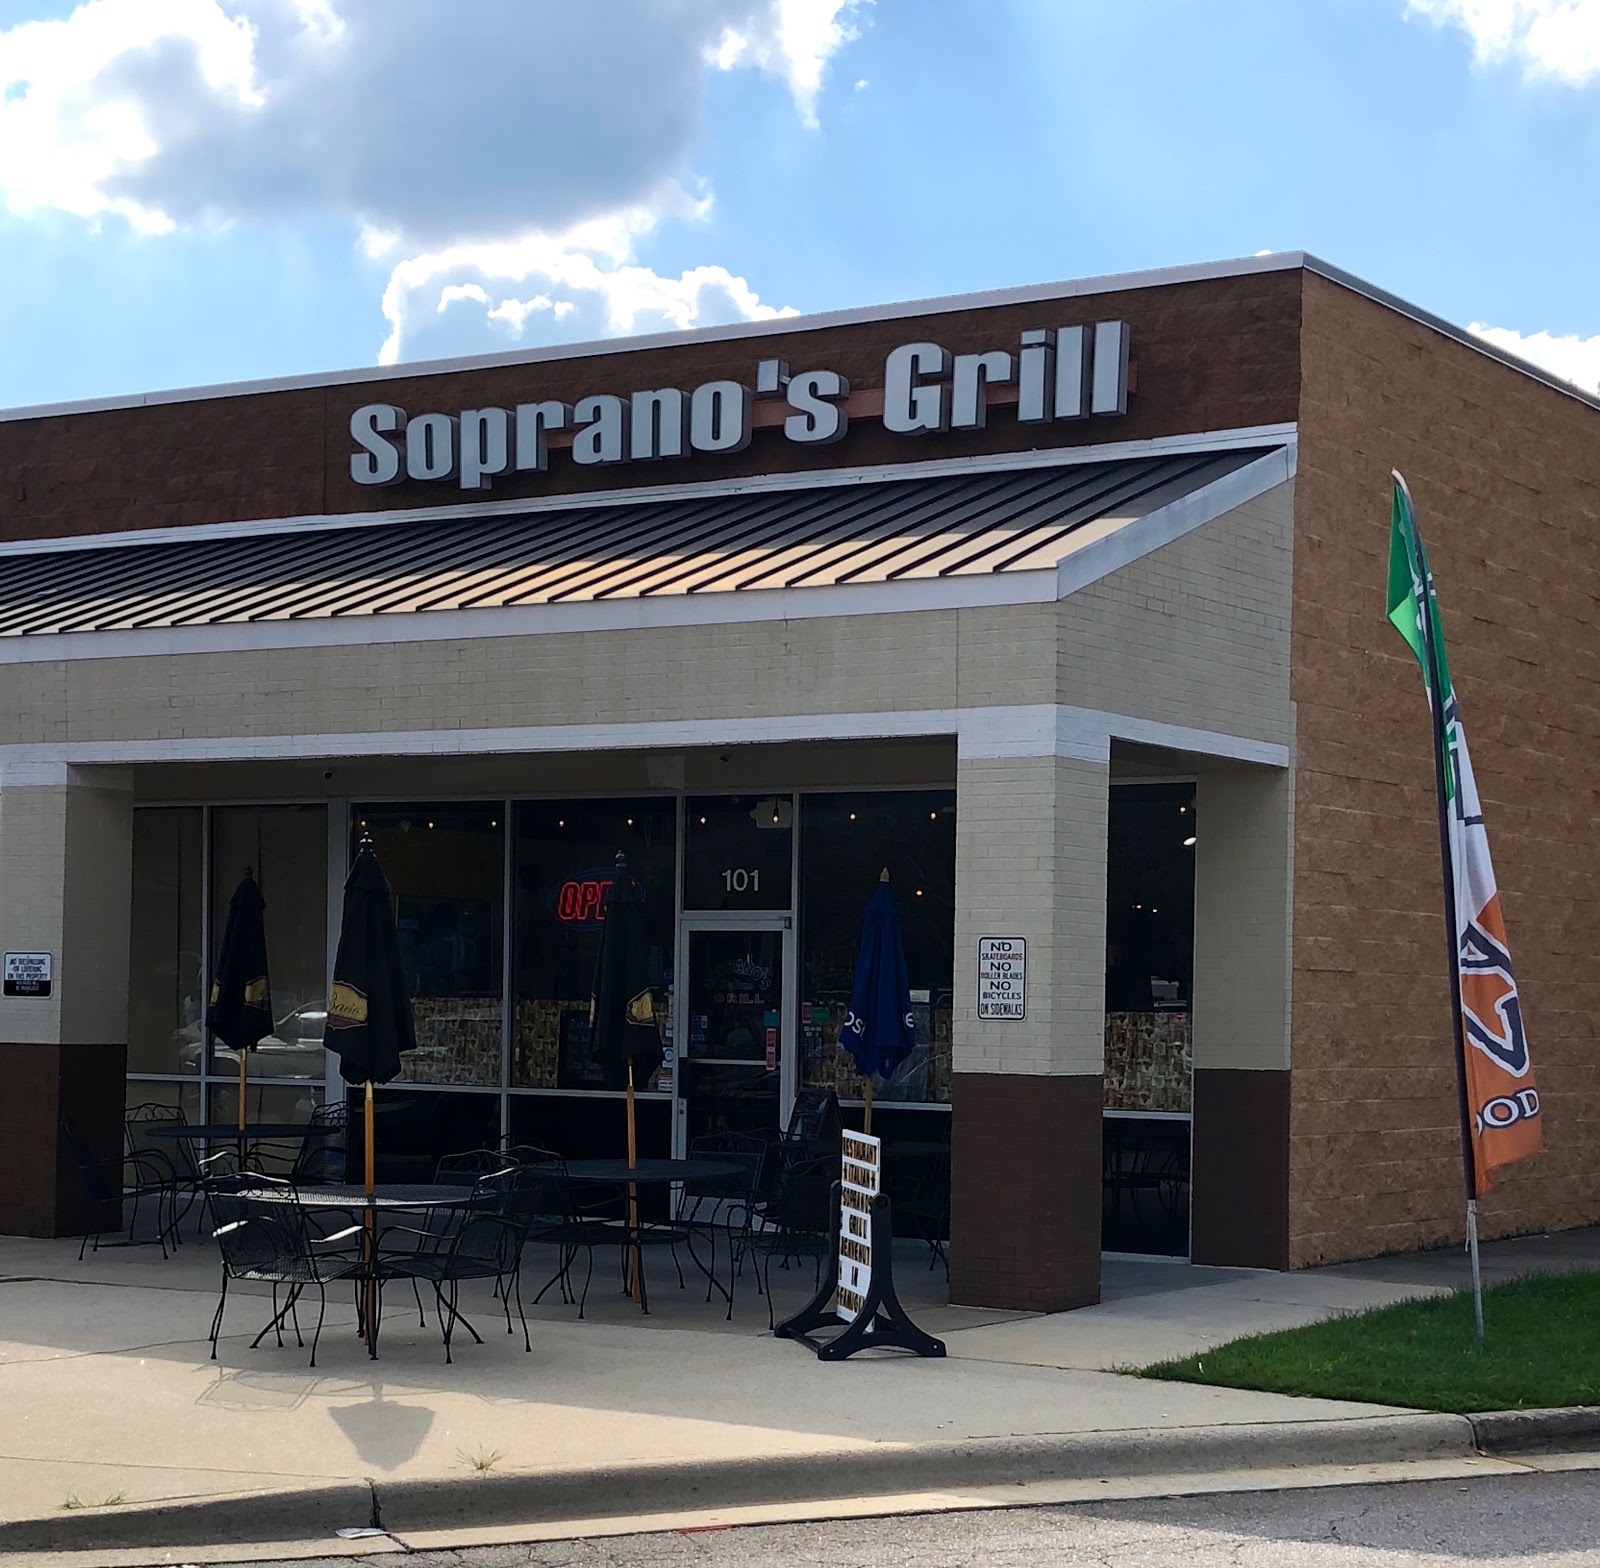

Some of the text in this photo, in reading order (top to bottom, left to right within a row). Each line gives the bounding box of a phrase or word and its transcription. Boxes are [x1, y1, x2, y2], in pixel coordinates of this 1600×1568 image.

[349, 320, 1130, 490] Soprano's Grill
[721, 868, 760, 892] 101
[558, 881, 615, 921] OPE
[990, 942, 1012, 952] NO
[981, 953, 1022, 961] SKATEBOARDS
[990, 961, 1012, 972] NO
[1002, 972, 1023, 980] BLADES
[989, 981, 1012, 991] NO
[982, 992, 1022, 1000] BICYCLES
[990, 1002, 1022, 1016] SIDEWALKS
